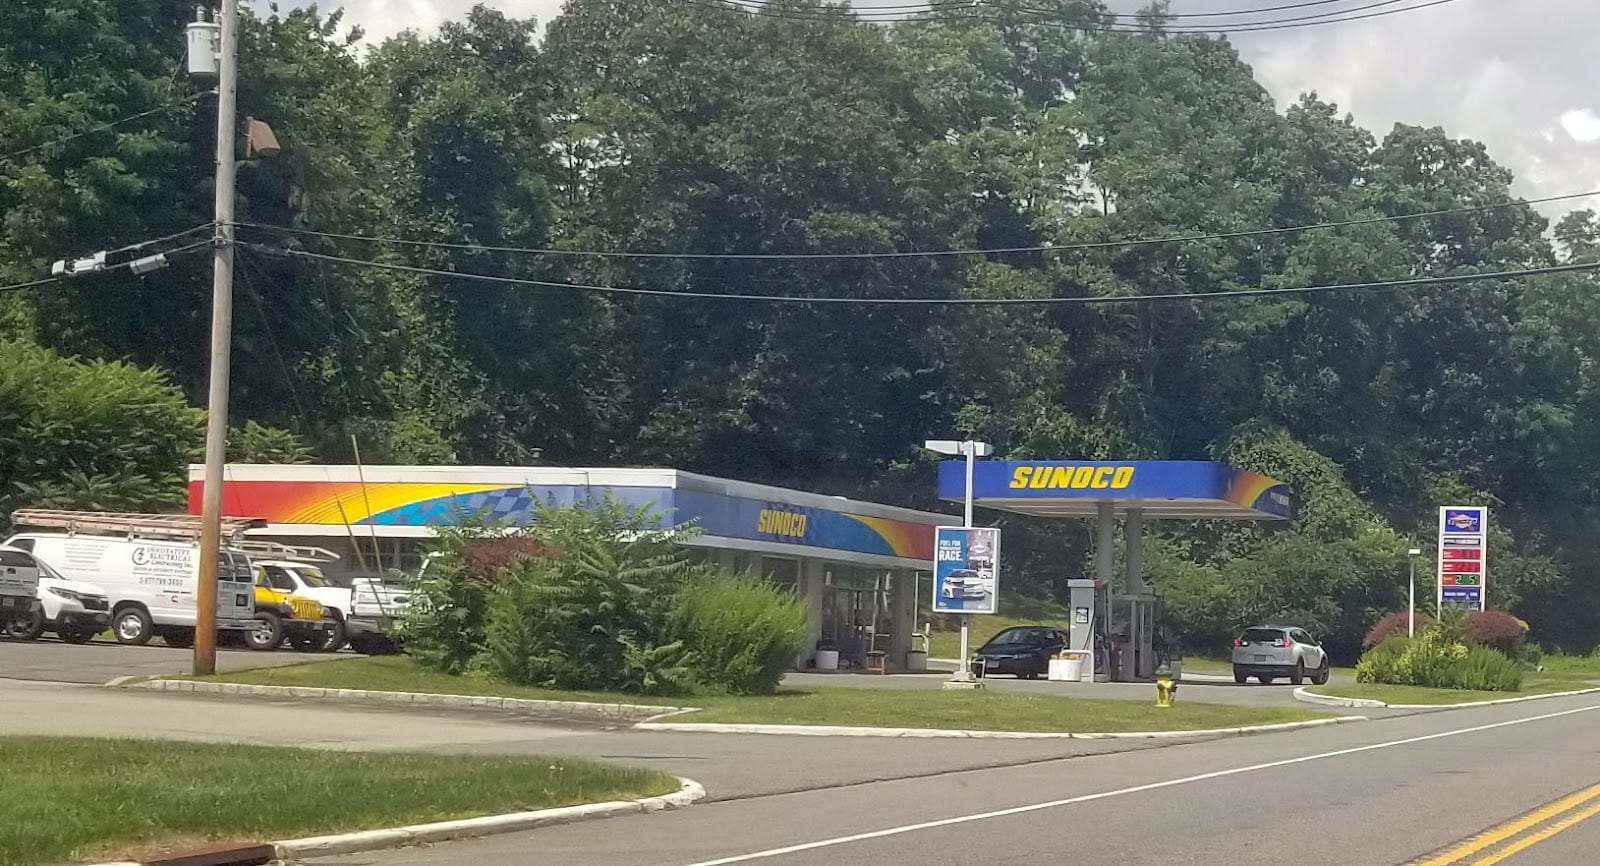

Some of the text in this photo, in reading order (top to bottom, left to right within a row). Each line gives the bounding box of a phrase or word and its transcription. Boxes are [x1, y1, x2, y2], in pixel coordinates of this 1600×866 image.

[1009, 466, 1135, 489] SUNOCO
[758, 509, 807, 537] SUNOCO
[150, 553, 191, 561] ELECTRICAL
